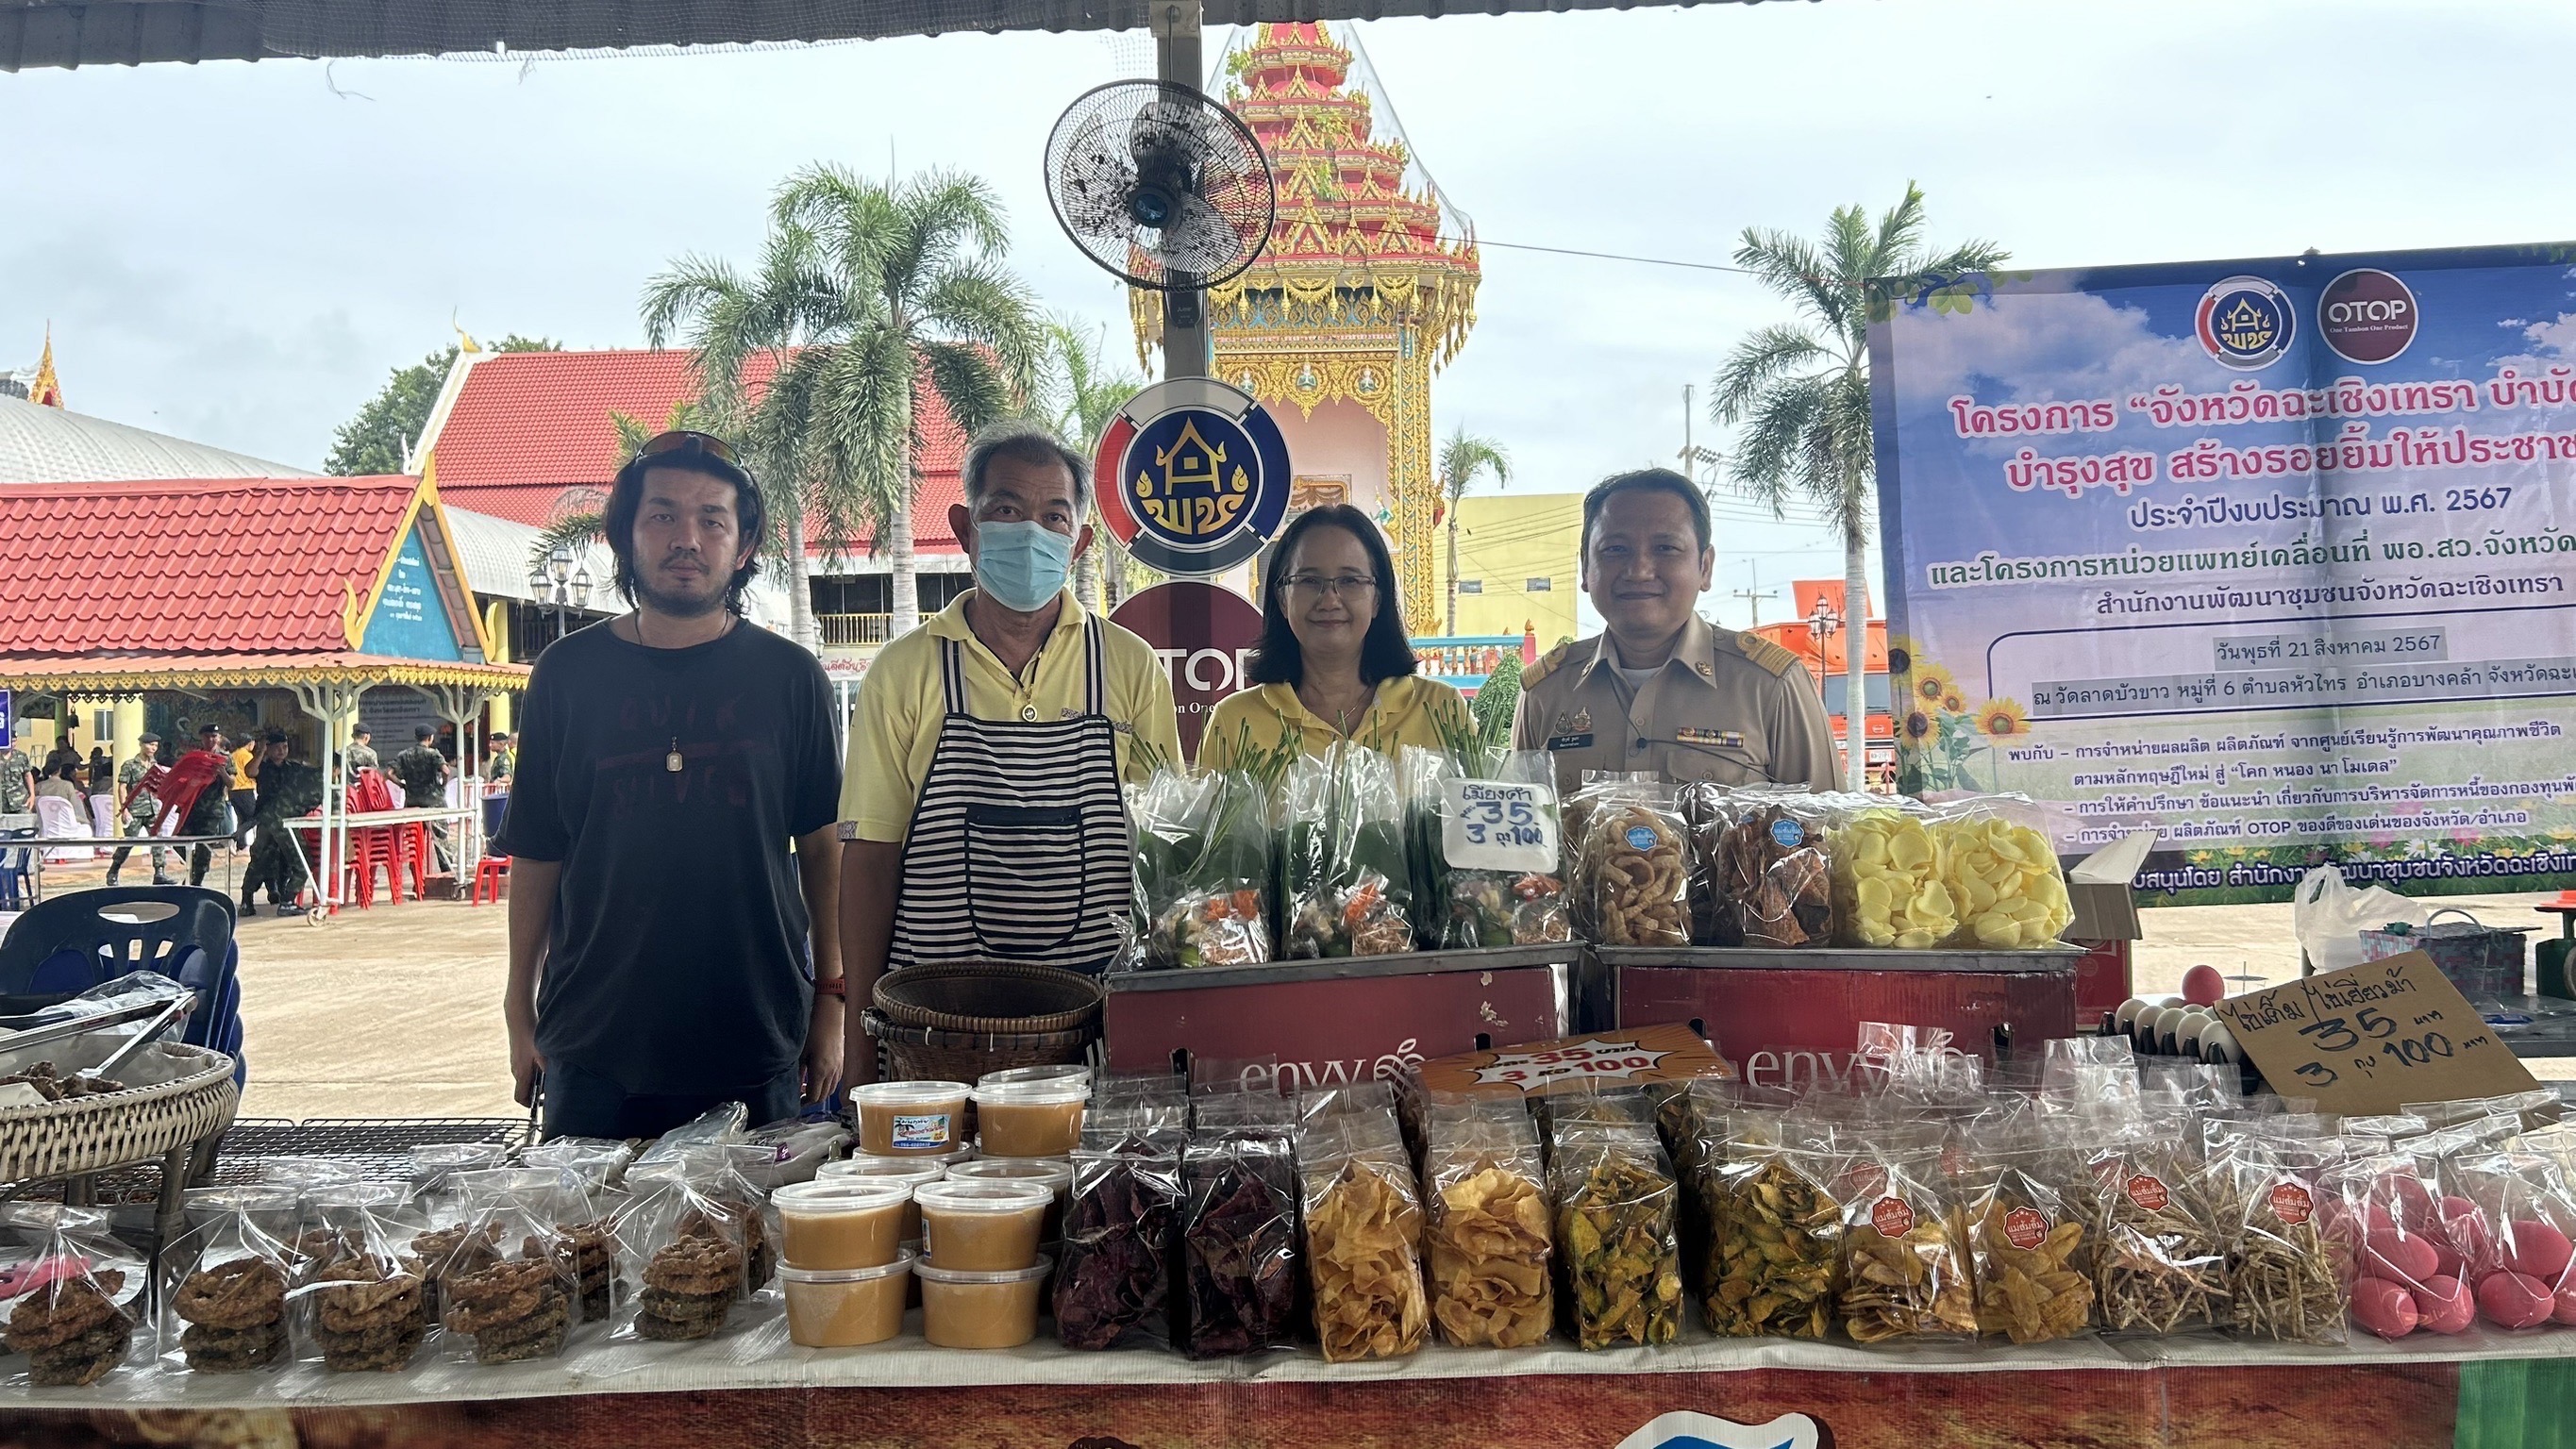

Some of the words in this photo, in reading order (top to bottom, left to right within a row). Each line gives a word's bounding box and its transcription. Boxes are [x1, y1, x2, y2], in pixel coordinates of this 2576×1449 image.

[2328, 300, 2407, 323] OTOP
[1951, 399, 2114, 434] โครงการ
[2008, 451, 2153, 494] บำรุงสุข
[2131, 493, 2371, 528] ประจำปีงบประมาณ
[2381, 491, 2436, 515] พ.ศ.
[2446, 487, 2513, 512] 2567
[1931, 528, 2372, 585] และโครงการหน่วยแพทย์เคลื่อนที่
[2097, 574, 2564, 614] สำนักงานพัฒนาชุมชนจังหวัดฉะเชิงเทรา
[2216, 636, 2282, 665] วันพุธที่
[2287, 641, 2310, 658] 21
[2314, 639, 2386, 657] สิงหาคม
[2392, 634, 2441, 652] 2567
[2032, 691, 2051, 706] ณ
[2055, 682, 2170, 705] วัดลาดบัวขาว
[2177, 674, 2216, 704] หมู่ที่
[2223, 679, 2235, 696] 6
[2242, 672, 2348, 696] ตำบลหัวไทร
[2356, 667, 2483, 691] อำเภอบางคล้า
[2008, 744, 2054, 761] พบกับ
[2075, 739, 2211, 758] การจำหน่ายผลผลิต
[2216, 732, 2285, 753] ผลิตภัณฑ์
[2290, 722, 2562, 752] จากศูนย์เรียนรู้การพัฒนาคุณภาพชีวิต
[2073, 765, 2210, 786] ตามหลักทฤษฎีใหม่
[2216, 764, 2226, 786] สู่
[2231, 762, 2267, 778] “โคก
[2272, 764, 2314, 777] หนอง
[2079, 794, 2195, 814] การให้คำปรึกษา
[2199, 790, 2270, 809] ข้อแนะนำ
[1466, 824, 1486, 844] 3
[2173, 819, 2241, 838] ผลิตภัณฑ์
[2248, 821, 2291, 835] OTOP
[2297, 808, 2527, 833] ของดีของเด่นของจังหวัด/อำเภอ
[2299, 1007, 2398, 1052] 35
[1500, 1070, 1528, 1082] 3
[1573, 1057, 1649, 1073] 100
[1531, 1047, 1593, 1065] 35
[1596, 1045, 1636, 1055] บาท
[2293, 1061, 2339, 1087] 3
[2383, 1031, 2454, 1068] 100
